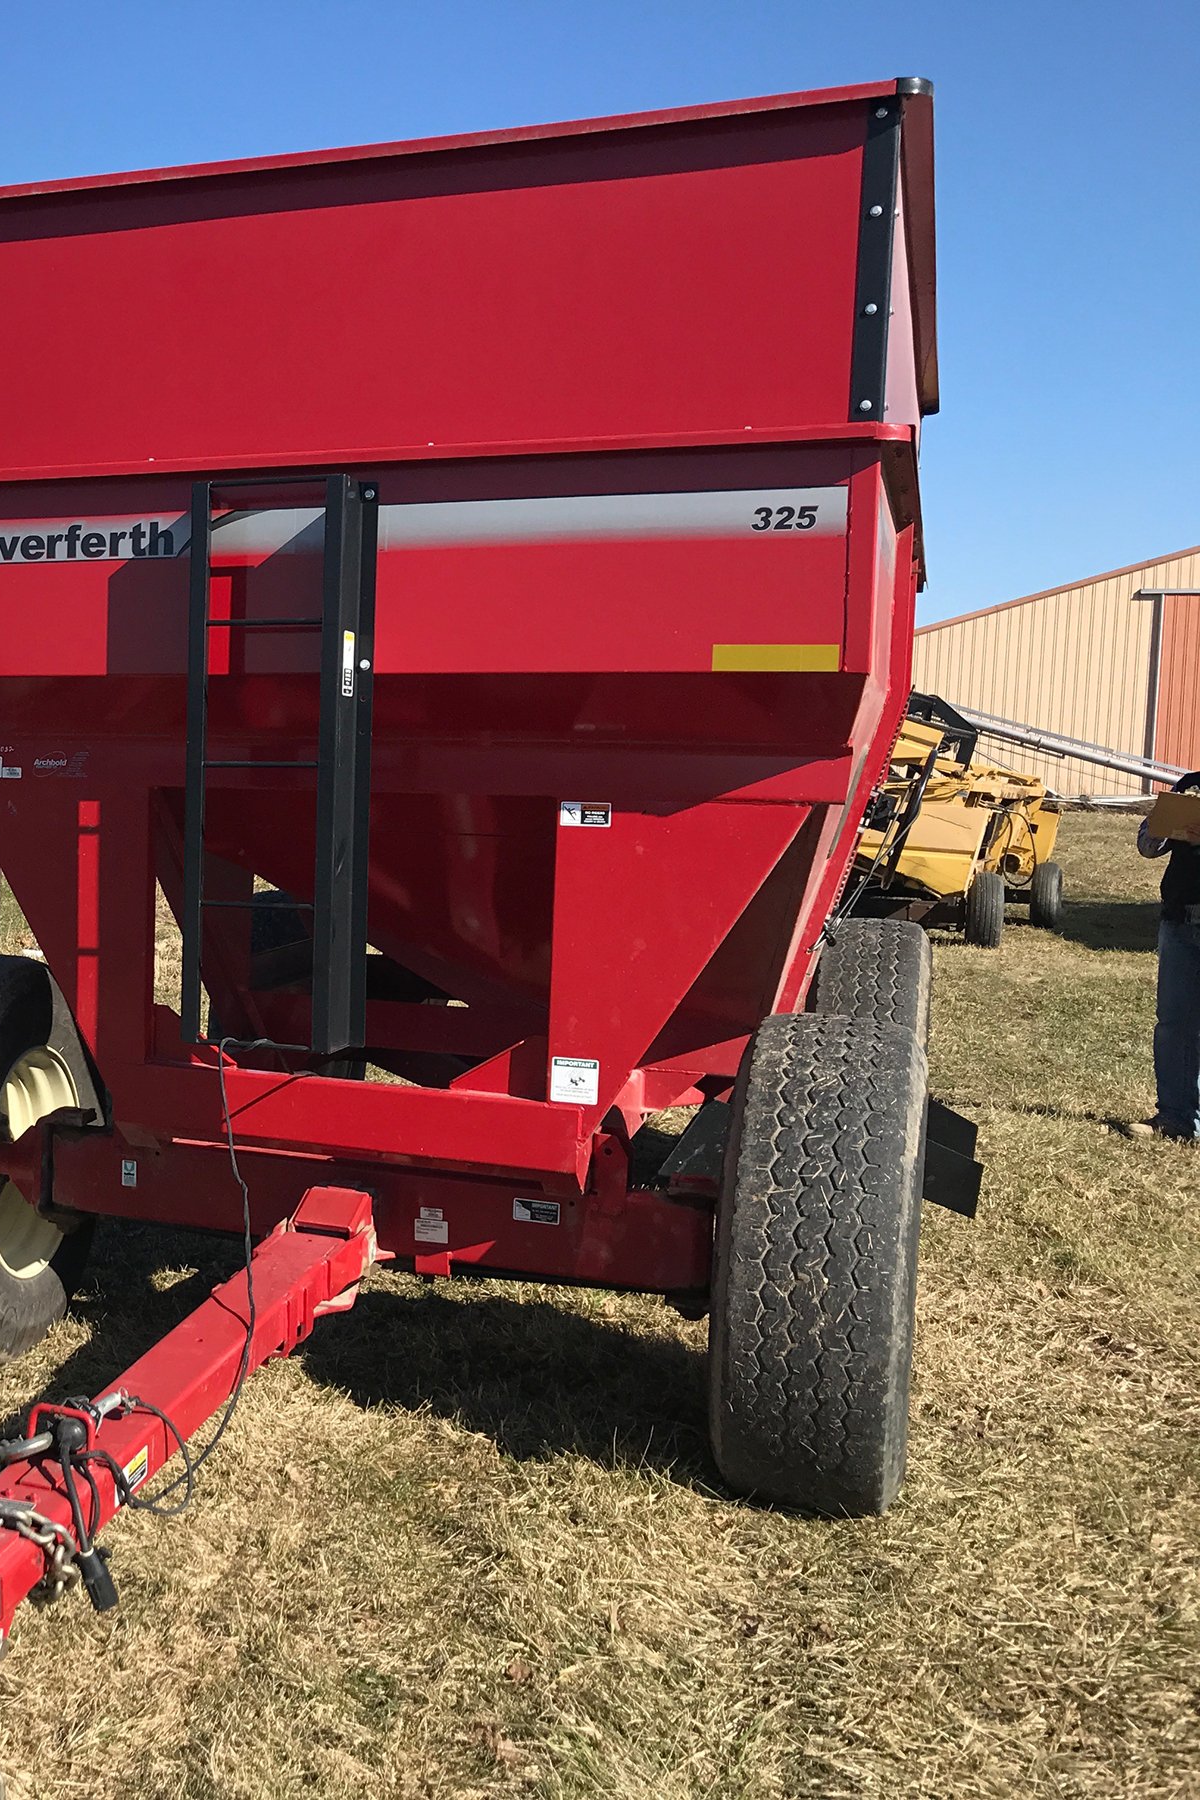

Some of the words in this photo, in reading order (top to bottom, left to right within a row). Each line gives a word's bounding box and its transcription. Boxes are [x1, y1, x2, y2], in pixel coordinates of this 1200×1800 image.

[751, 505, 819, 531] 325
[33, 758, 68, 767] Archbold
[556, 1059, 595, 1069] IMPORTANT
